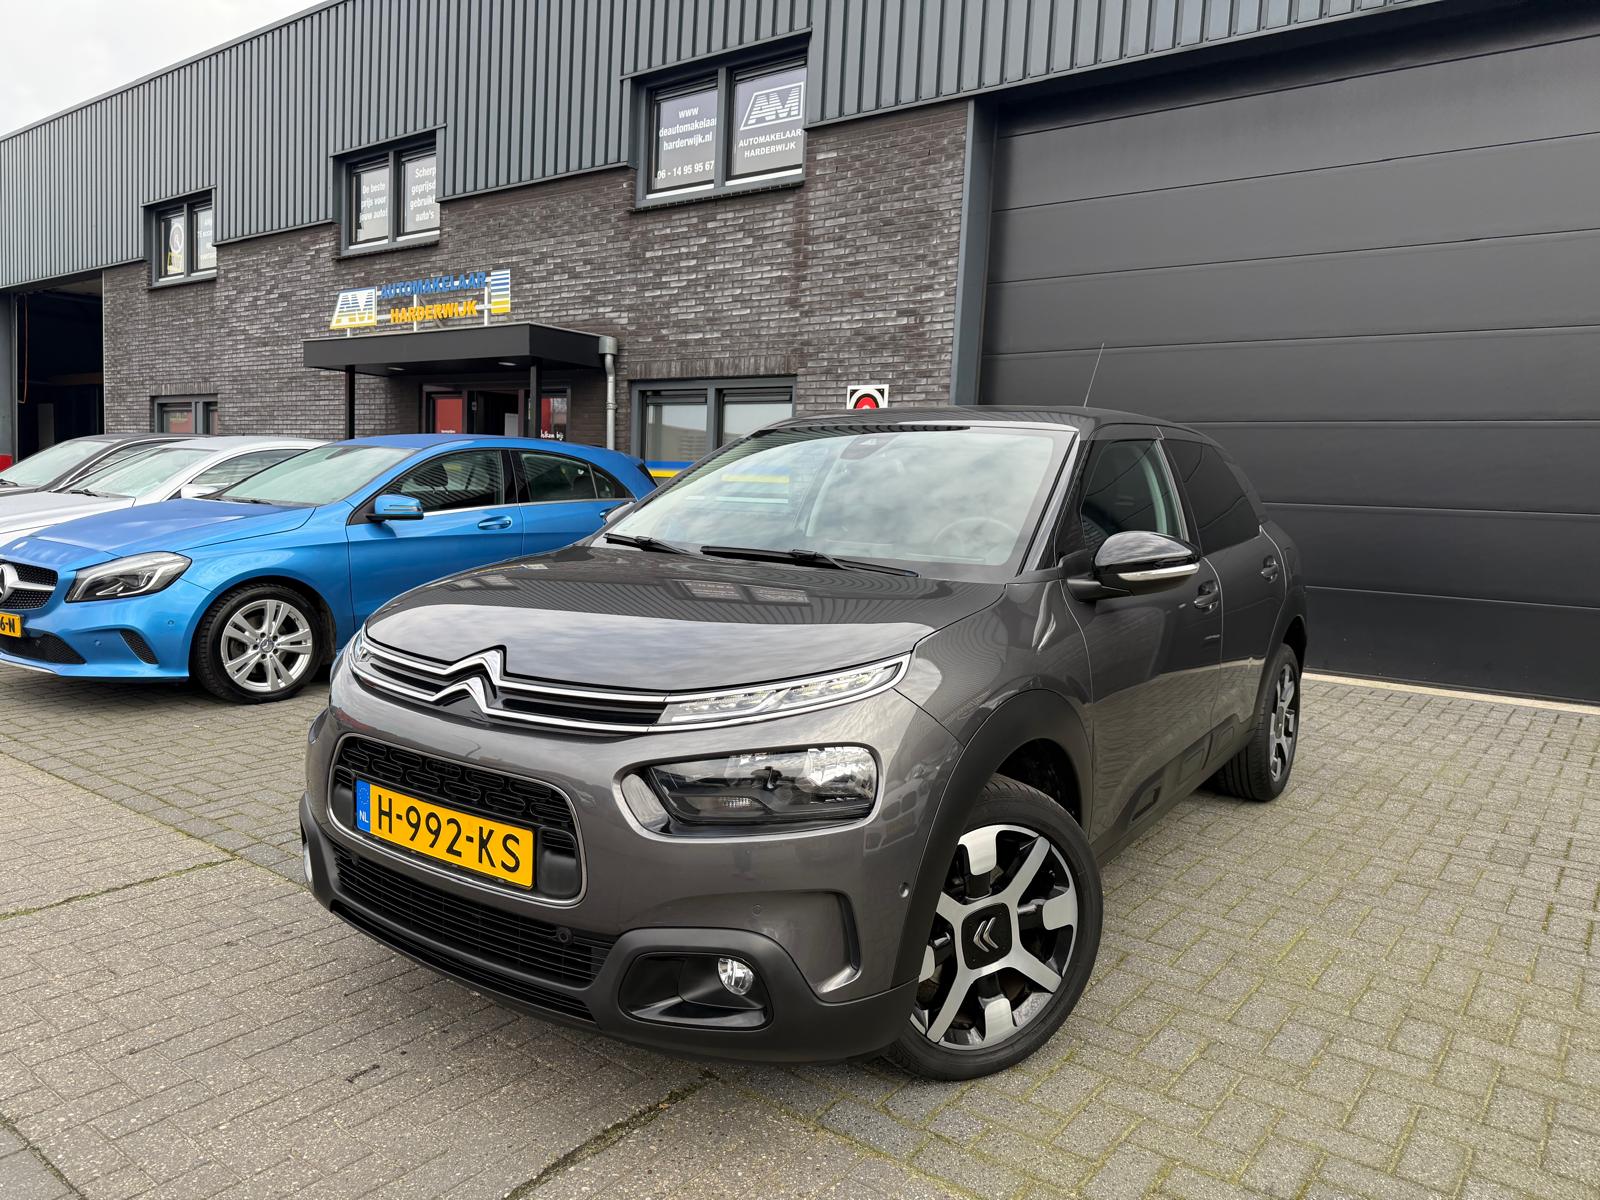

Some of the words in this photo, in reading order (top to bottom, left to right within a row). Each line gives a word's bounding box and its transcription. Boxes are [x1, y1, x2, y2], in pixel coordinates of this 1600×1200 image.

[678, 106, 699, 119] www
[663, 132, 712, 151] harderwijk.nl
[738, 128, 802, 148] AUTOMAKELAAR
[744, 142, 796, 158] HARDERWIJK
[657, 169, 666, 179] 06
[673, 166, 681, 176] 14
[683, 164, 692, 174] 95
[694, 162, 703, 172] 95
[705, 160, 714, 170] 67
[380, 271, 486, 300] AUTOMAKELAAR
[390, 300, 478, 324] HARDERWIJK
[359, 810, 369, 823] NL
[377, 794, 521, 874] H-992-KS
